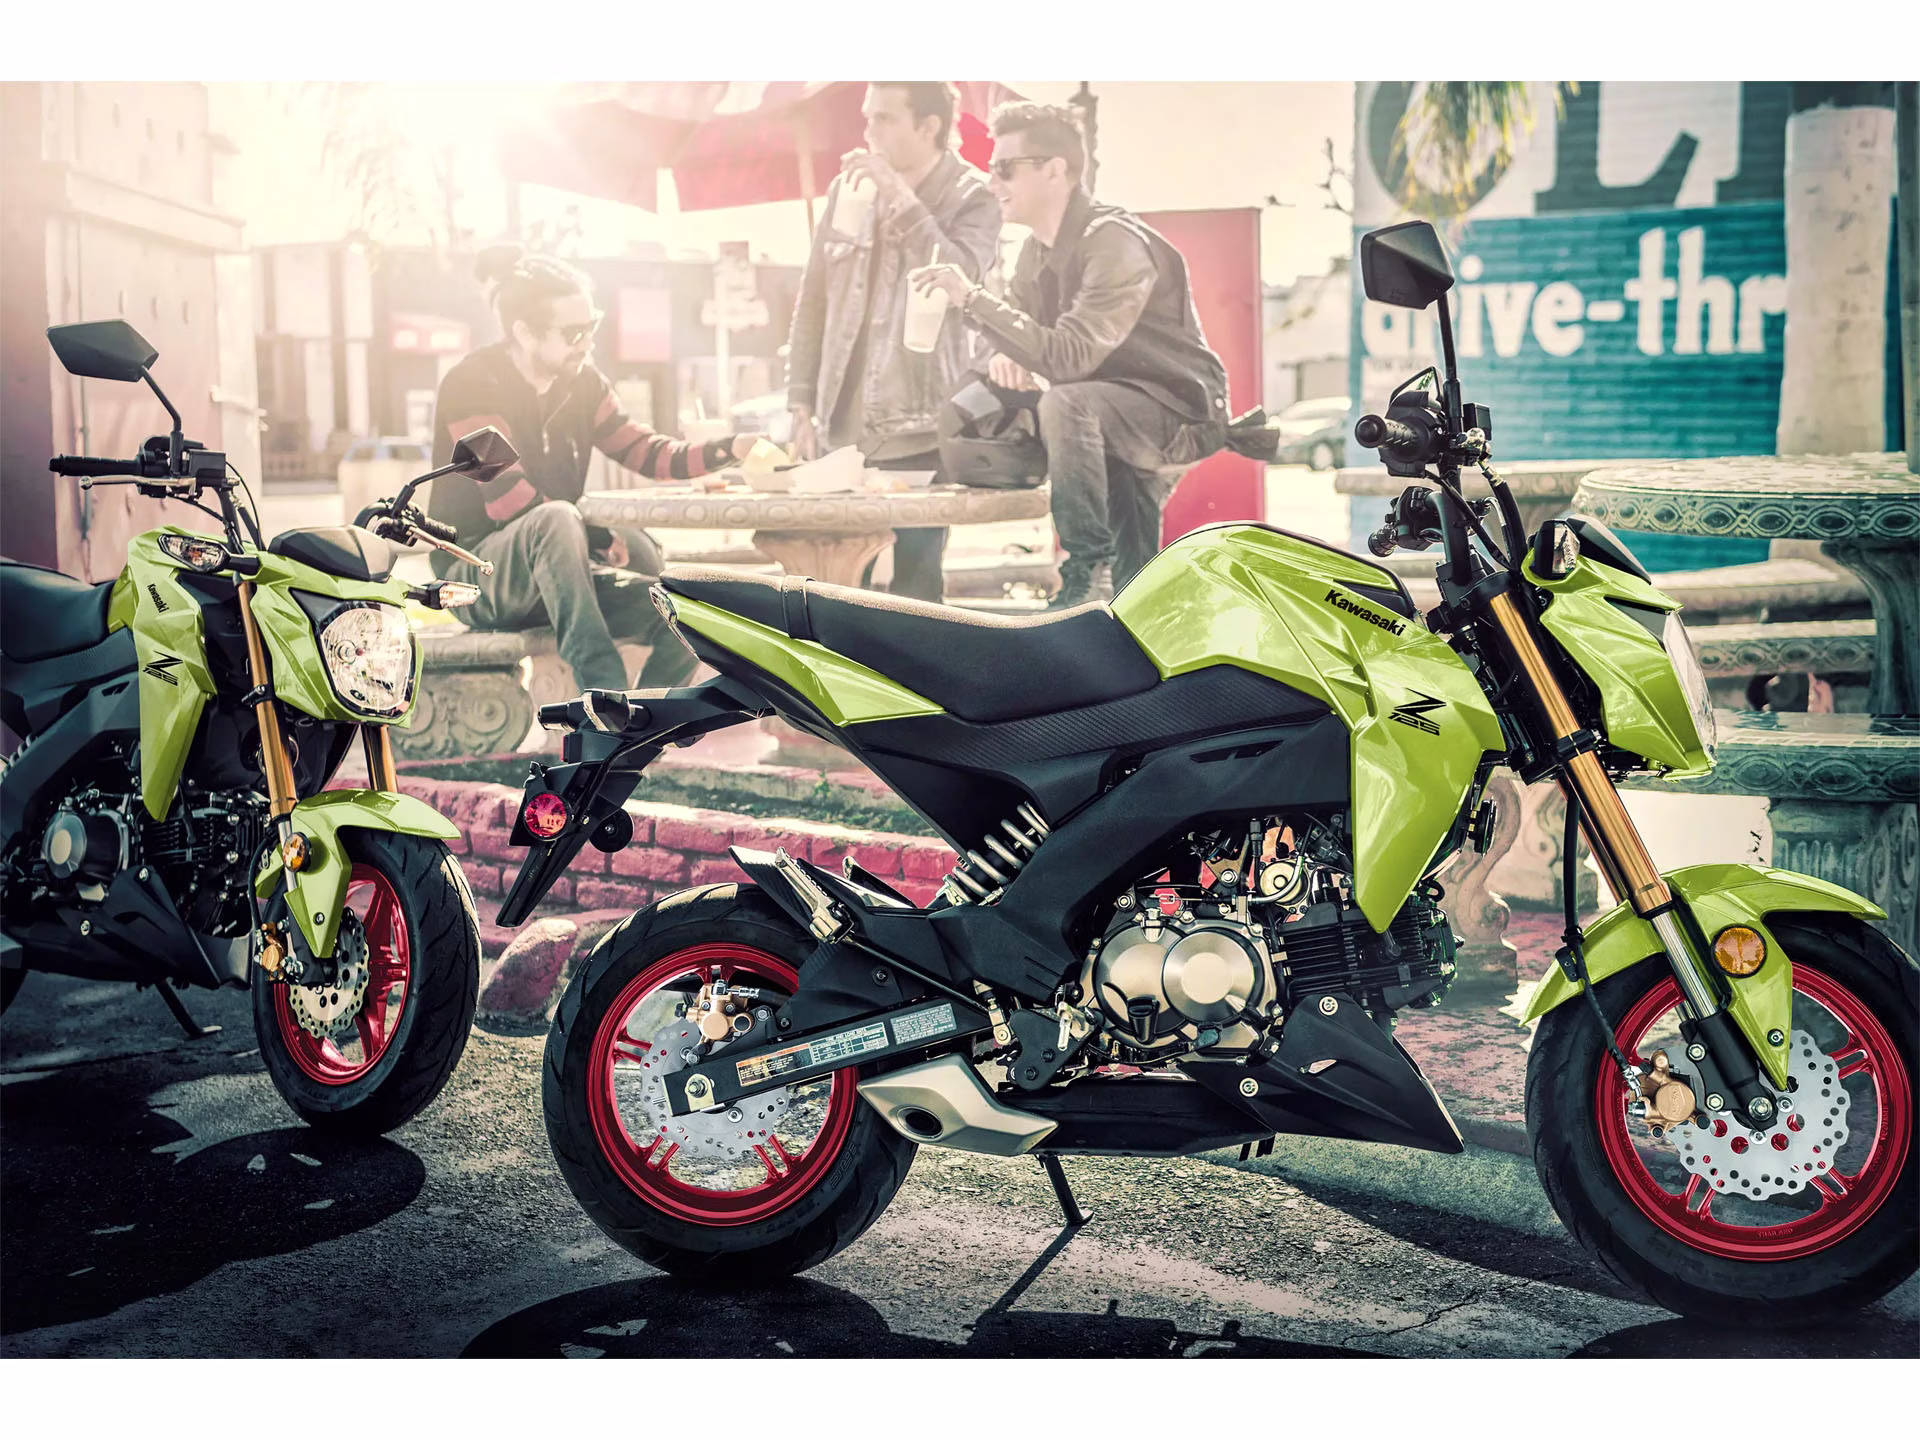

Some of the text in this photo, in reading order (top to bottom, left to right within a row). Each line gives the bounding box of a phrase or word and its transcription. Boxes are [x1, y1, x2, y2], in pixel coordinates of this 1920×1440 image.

[147, 583, 170, 613] Kawasaki
[1324, 589, 1407, 637] Kawasaki
[1387, 711, 1441, 737] 125
